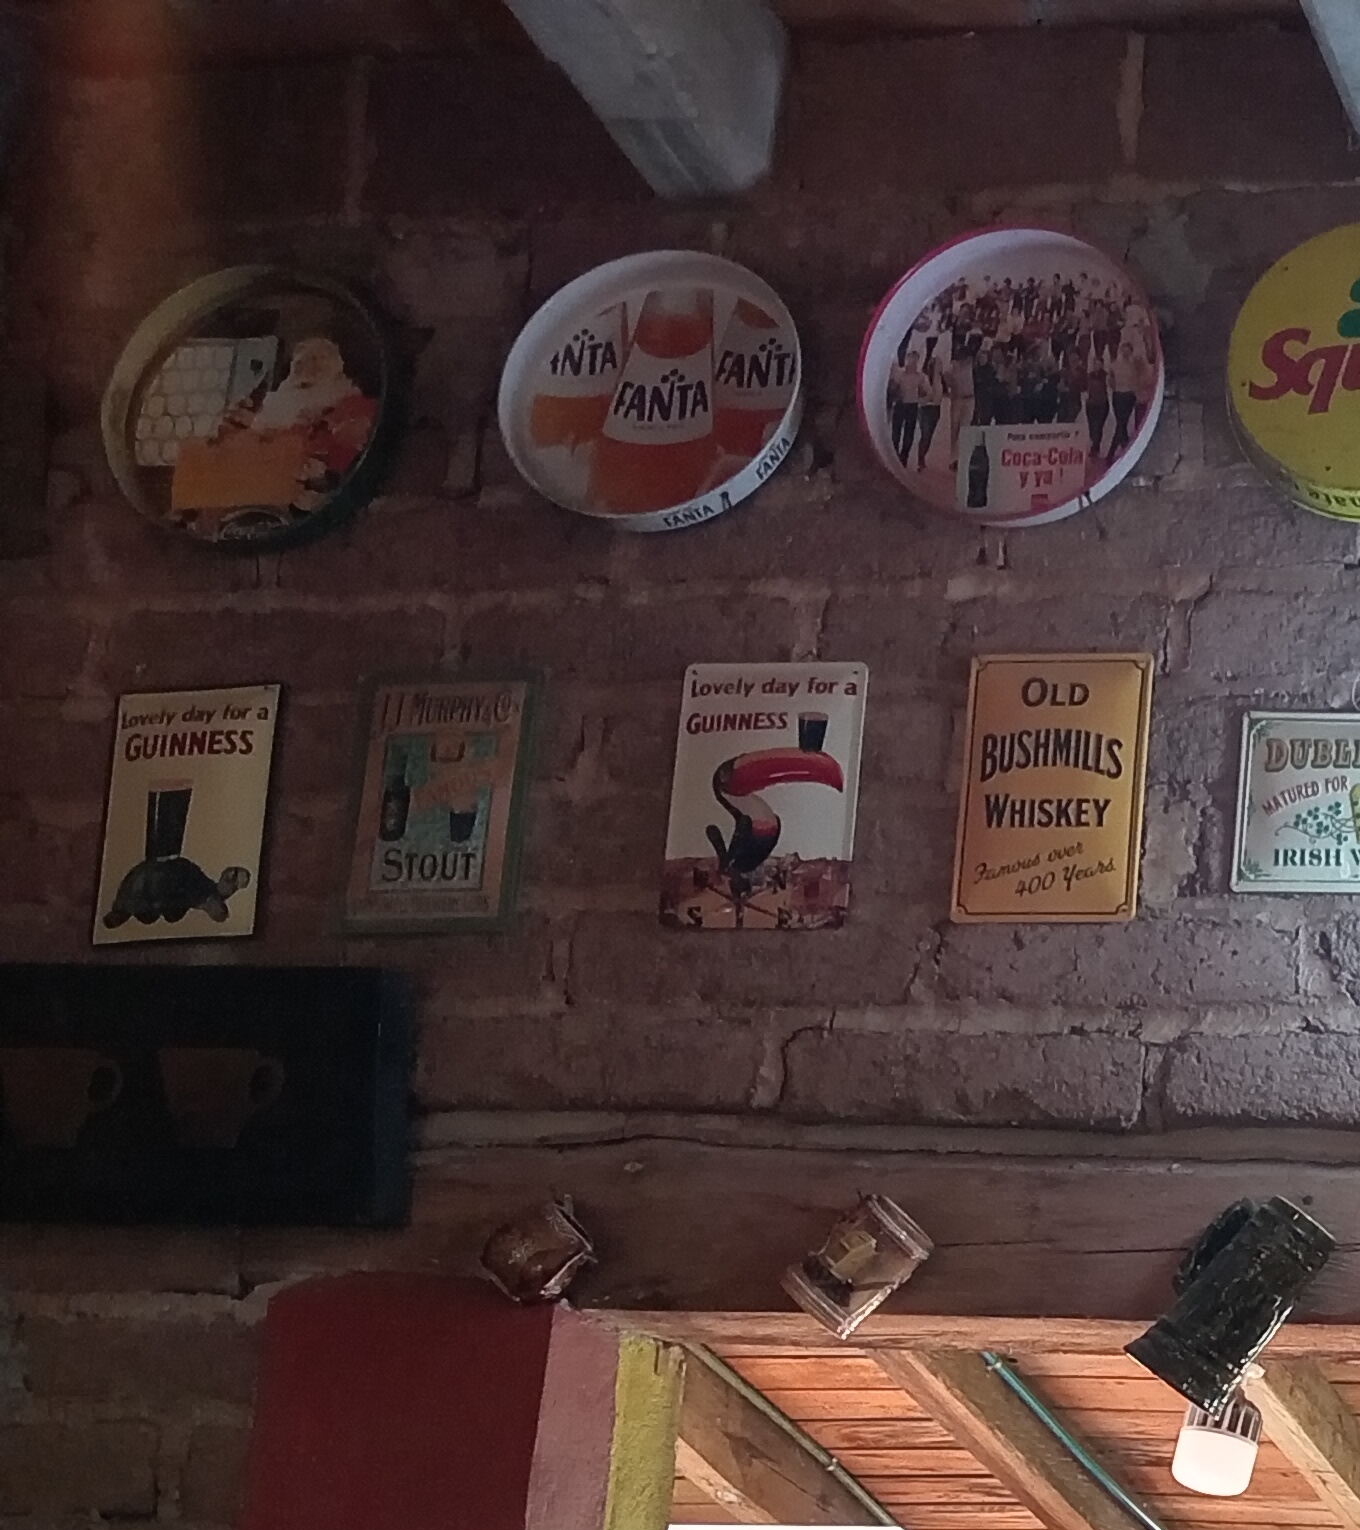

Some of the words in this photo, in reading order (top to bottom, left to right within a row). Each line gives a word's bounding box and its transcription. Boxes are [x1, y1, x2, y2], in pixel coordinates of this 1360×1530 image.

[613, 372, 709, 422] FANTA
[1001, 446, 1084, 468] Coca-Cola
[691, 677, 756, 698] Lovely
[761, 677, 800, 698] day
[806, 676, 839, 696] for
[844, 681, 858, 696] a
[1020, 676, 1091, 708] OLD
[121, 709, 181, 730] Lovely
[181, 704, 218, 726] day
[222, 703, 253, 721] for
[257, 706, 269, 721] a
[685, 711, 789, 735] GUINNESS
[124, 729, 255, 762] GUINNESS
[980, 727, 1124, 783] BUSHMILLS
[984, 793, 1113, 830] WHISKEY
[1260, 780, 1320, 818] MATURED
[1324, 774, 1349, 794] FOR
[381, 849, 477, 883] STOUT
[973, 852, 1041, 885] Famous
[1047, 841, 1083, 863] over
[1272, 848, 1343, 867] IRISH
[1014, 871, 1056, 898] 400
[1061, 857, 1117, 893] Years
